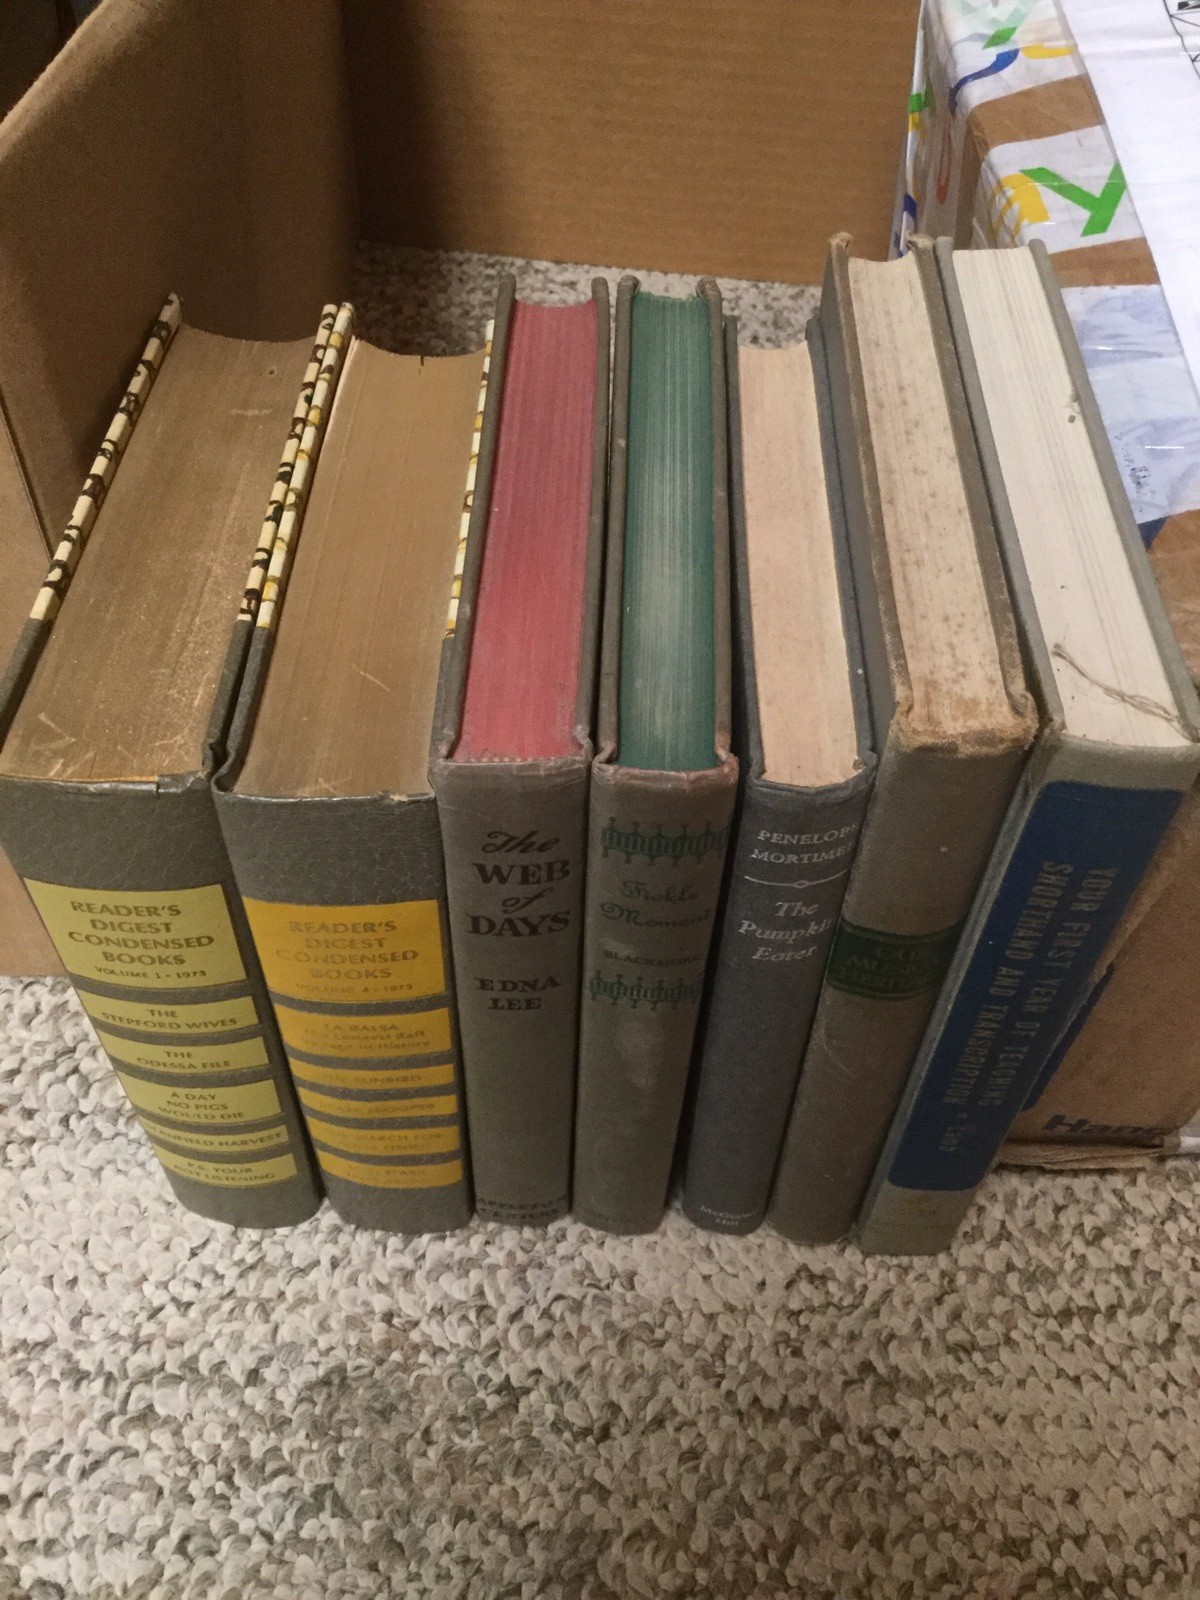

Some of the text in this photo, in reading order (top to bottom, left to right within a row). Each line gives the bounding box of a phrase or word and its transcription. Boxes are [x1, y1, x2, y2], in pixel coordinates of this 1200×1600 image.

[481, 830, 560, 854] The
[751, 840, 855, 864] MORTIME
[472, 859, 571, 885] WEB
[1070, 867, 1117, 912] YOUR
[501, 887, 554, 914] of
[71, 901, 182, 917] READER'S
[775, 902, 819, 917] The
[1004, 860, 1074, 961] SHORTHAND
[90, 919, 173, 934] DIGEST
[289, 920, 398, 934] READER'S
[465, 909, 571, 937] DAYS
[68, 931, 215, 949] CONDENSED
[304, 937, 387, 949] DIGEST
[1045, 922, 1091, 968] FIRST
[102, 951, 186, 966] BOOKS
[276, 949, 419, 965] CONDENSED
[752, 946, 818, 962] Eater
[95, 966, 149, 979] VOLUME
[176, 970, 207, 979] 1973
[310, 967, 393, 980] BOOKS
[473, 976, 562, 992] EDNA
[989, 967, 1025, 997] AND
[1022, 978, 1063, 1013] YEAR
[487, 997, 542, 1011] LEE
[101, 1012, 238, 1030] STEPFORD WIVES
[148, 1009, 178, 1018] THE
[1012, 1020, 1041, 1038] OF
[164, 1051, 194, 1059] THE
[202, 1060, 232, 1069] FILE
[185, 1092, 217, 1101] DAY
[167, 1101, 189, 1110] NO
[218, 1132, 283, 1147] HARVEST
